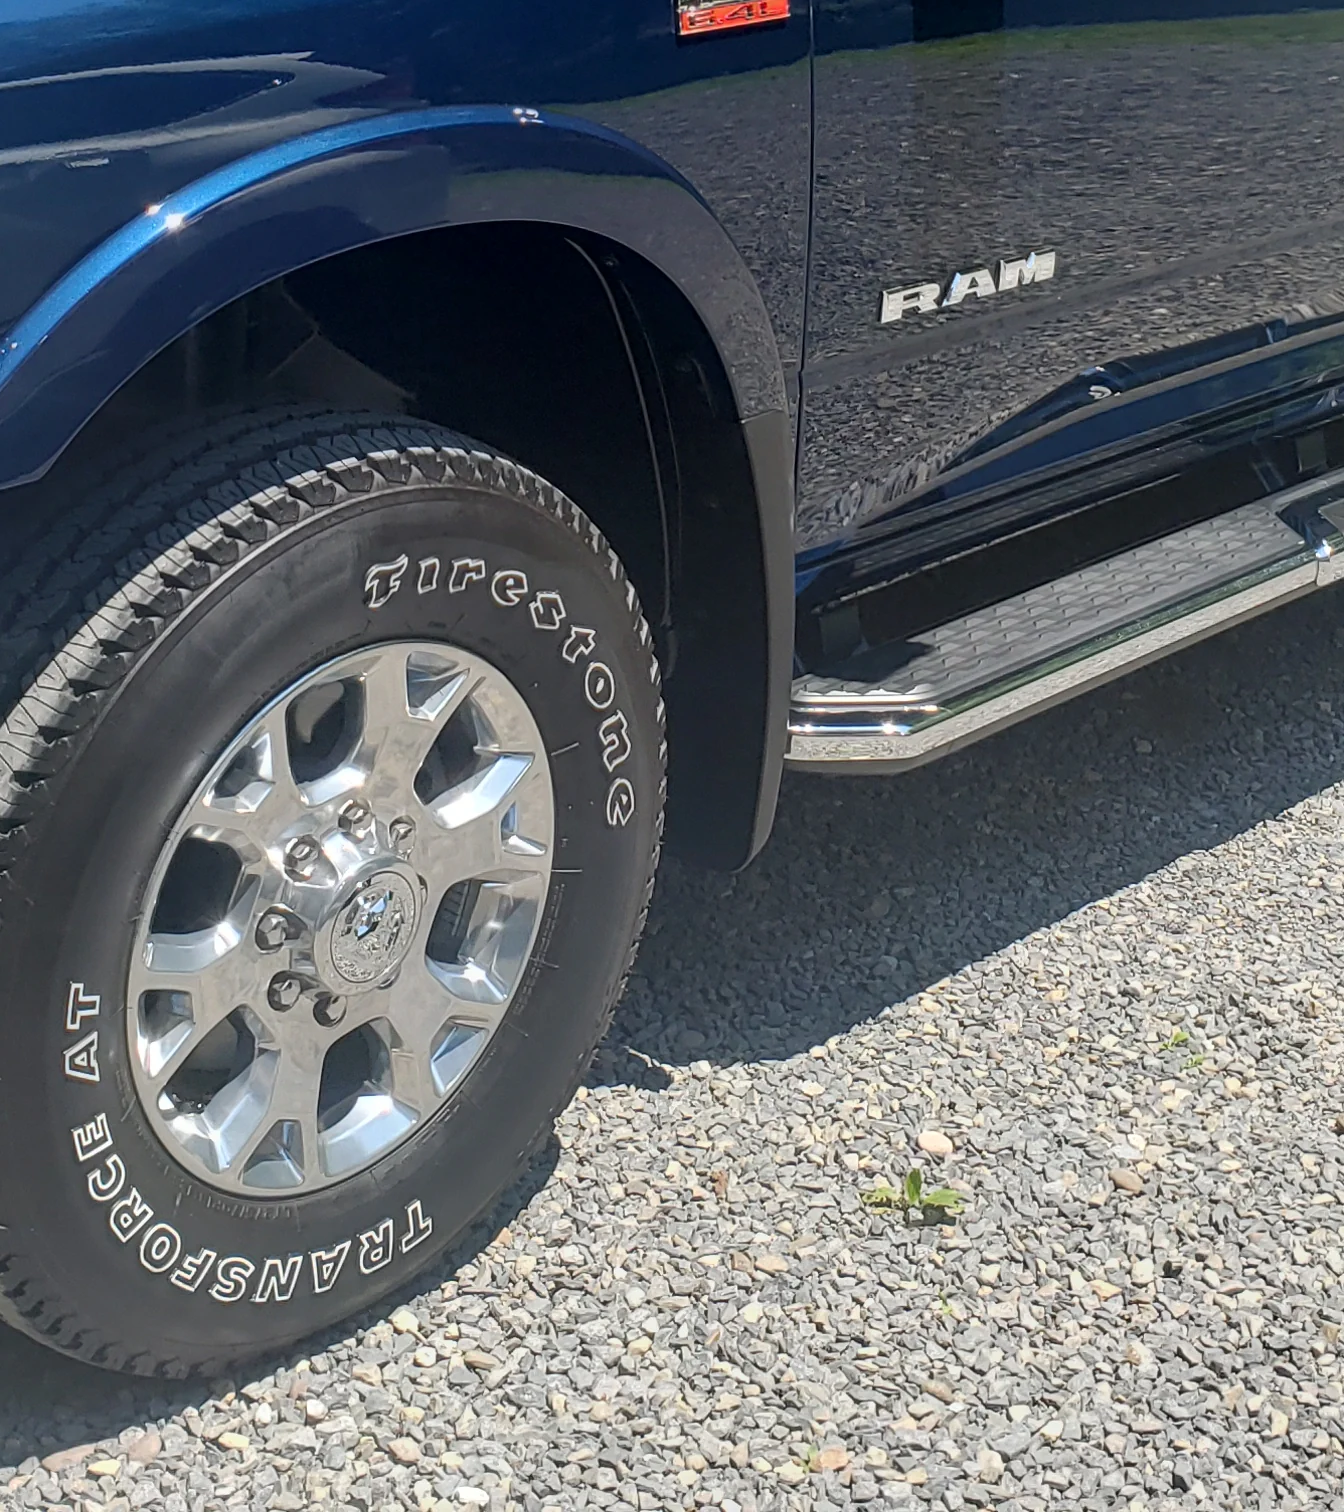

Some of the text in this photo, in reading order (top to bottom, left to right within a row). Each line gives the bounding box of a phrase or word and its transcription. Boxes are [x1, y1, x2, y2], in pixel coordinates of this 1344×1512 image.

[879, 246, 1056, 324] RAM
[364, 553, 635, 826] Firestone
[64, 981, 102, 1082] AT
[71, 1112, 434, 1303] TRANSFORCE
